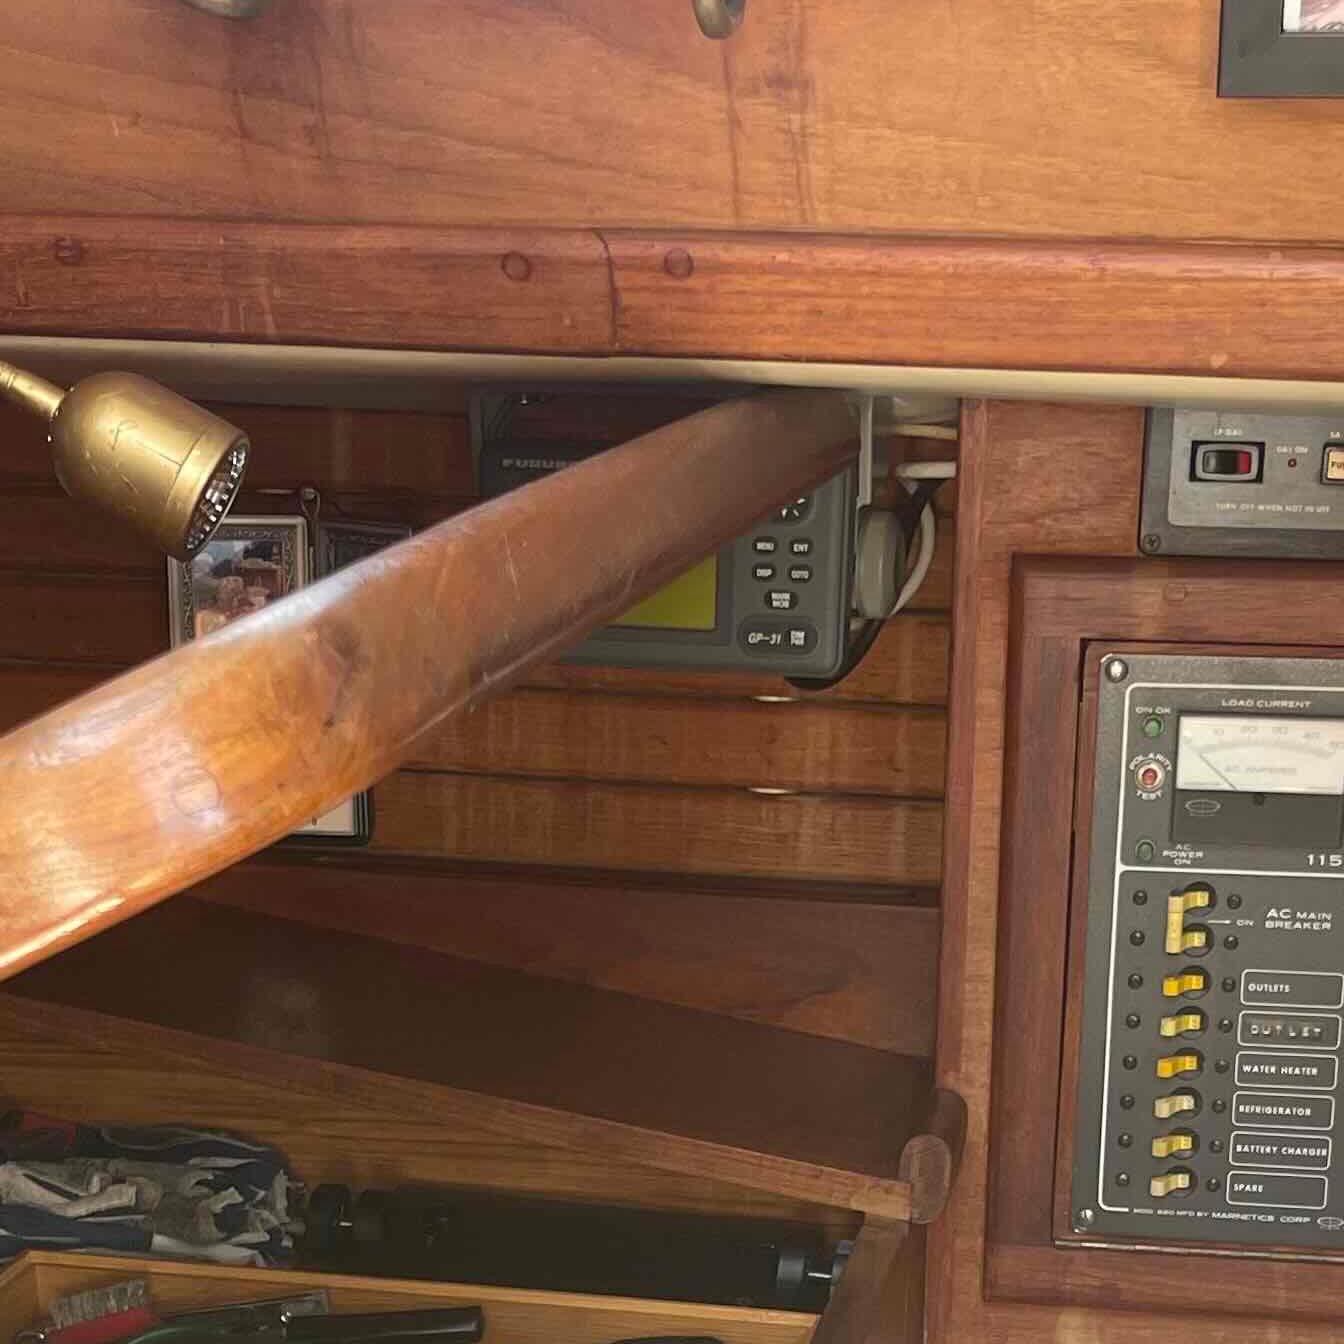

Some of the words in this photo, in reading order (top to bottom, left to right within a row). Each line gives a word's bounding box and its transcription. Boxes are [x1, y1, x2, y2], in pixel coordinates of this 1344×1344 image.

[1216, 503, 1237, 511] TURN
[793, 543, 809, 553] ENT
[1221, 699, 1254, 708] LOAD
[1256, 700, 1312, 710] CURRENT
[1135, 706, 1153, 715] ON
[1161, 850, 1205, 860] POWER
[1306, 852, 1344, 868] 115
[1173, 858, 1192, 867] ON
[1266, 907, 1292, 920] AC
[1295, 910, 1333, 921] MAIN
[1236, 918, 1256, 928] ON
[1264, 920, 1332, 931] BREAKER
[1247, 983, 1291, 994] OUTLETS
[1242, 1064, 1277, 1075] WATER
[1280, 1066, 1319, 1077] HEATER
[1238, 1104, 1313, 1117] REFRIGERATOR
[1236, 1144, 1279, 1156] BATTERY
[1281, 1146, 1328, 1158] CHARGER
[1279, 1215, 1312, 1224] CORP
